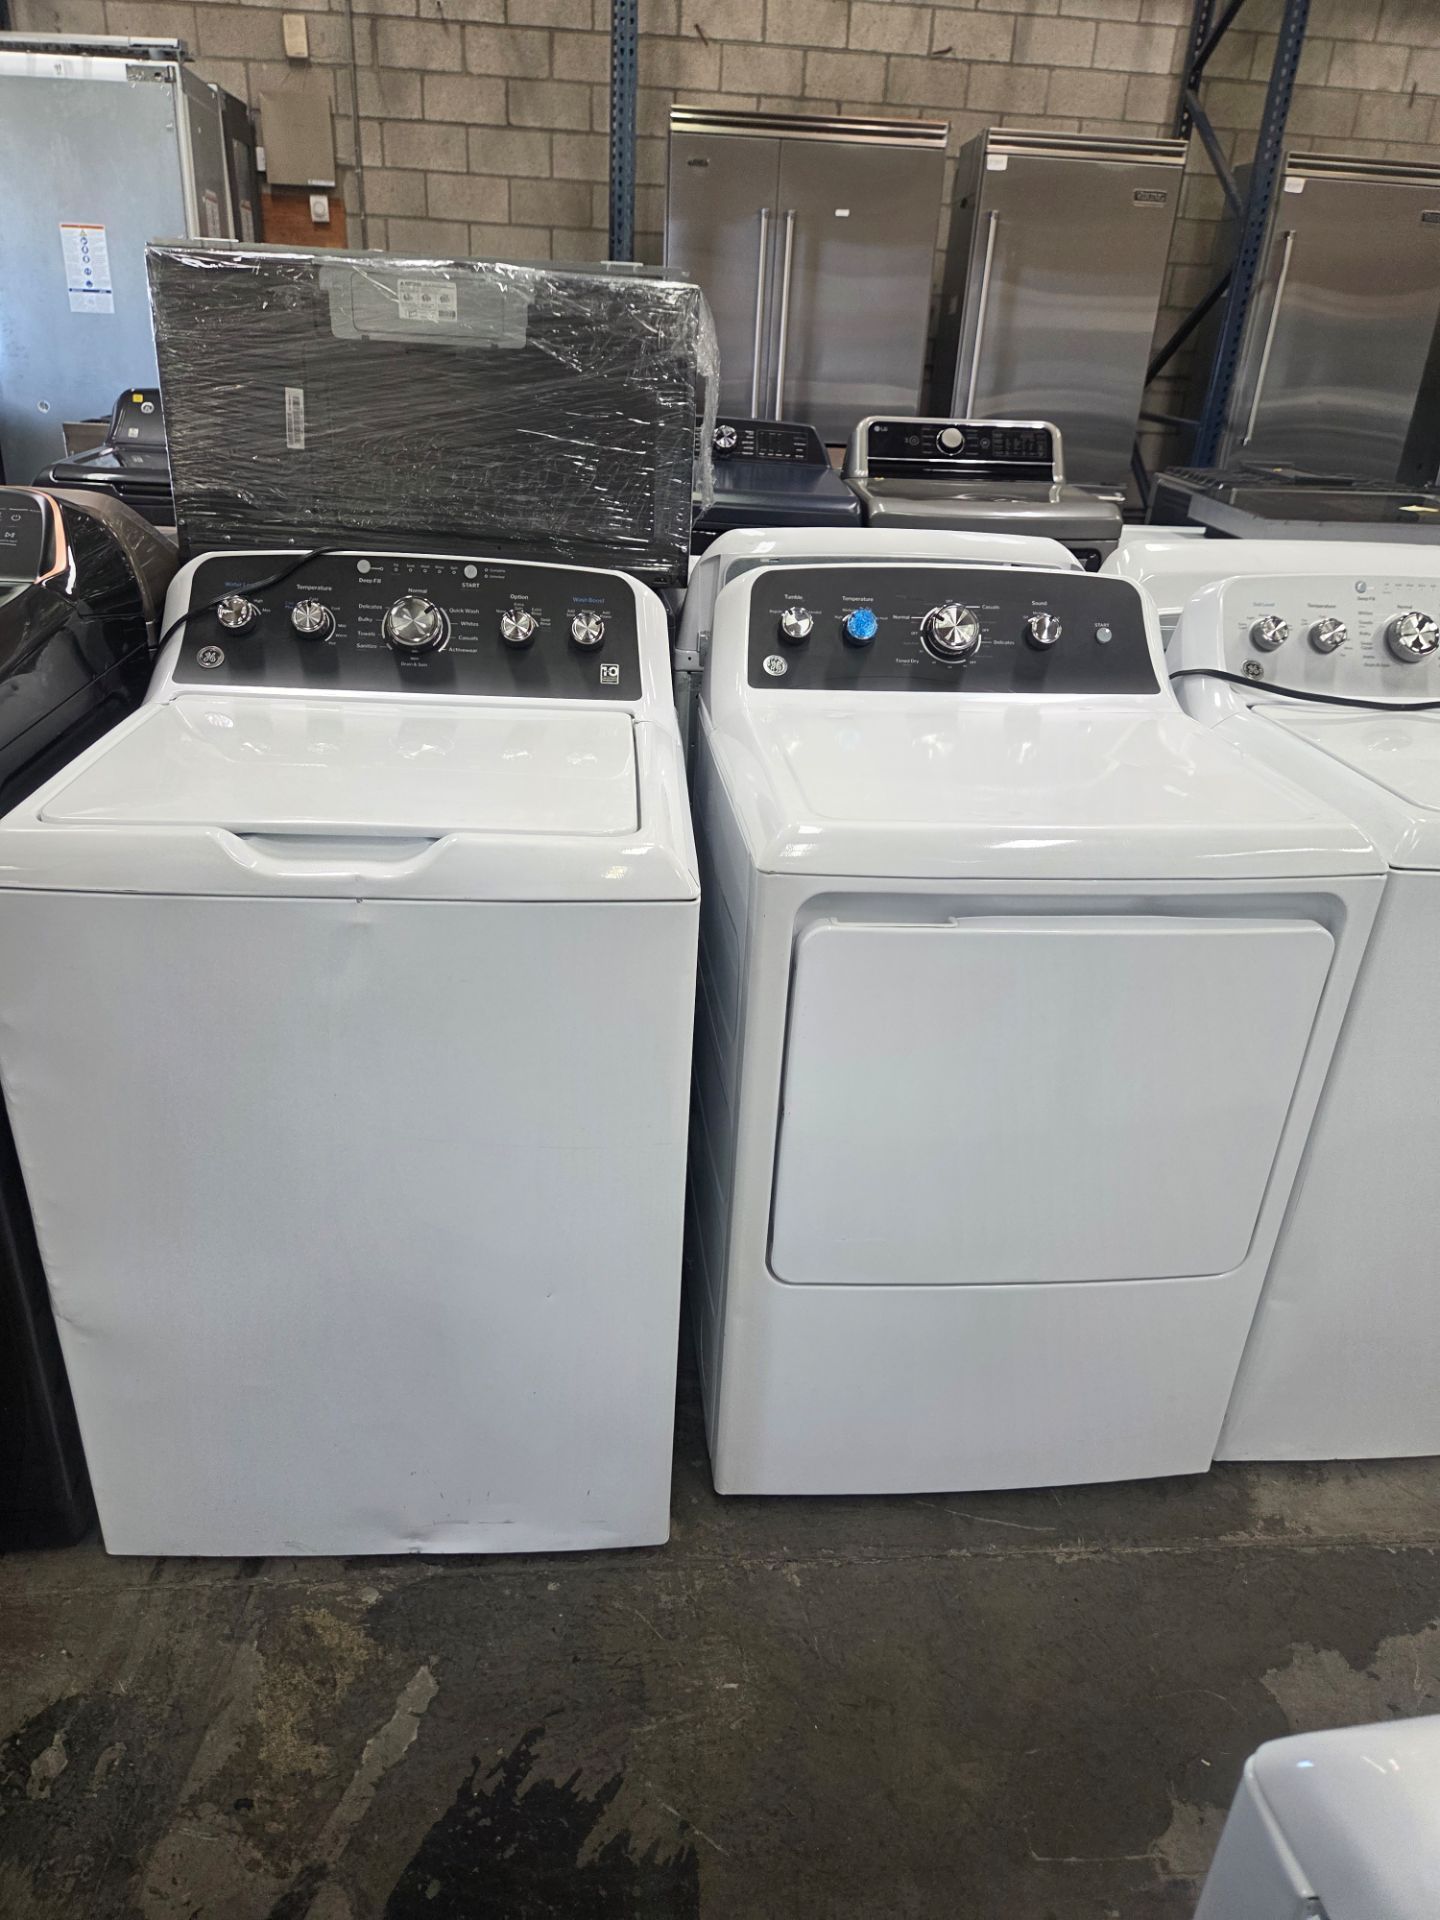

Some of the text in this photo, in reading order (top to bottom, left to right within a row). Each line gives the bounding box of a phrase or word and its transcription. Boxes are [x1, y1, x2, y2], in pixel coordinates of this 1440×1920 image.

[296, 583, 332, 592] Temperature
[509, 593, 529, 601] Option
[842, 595, 875, 603] Temperature
